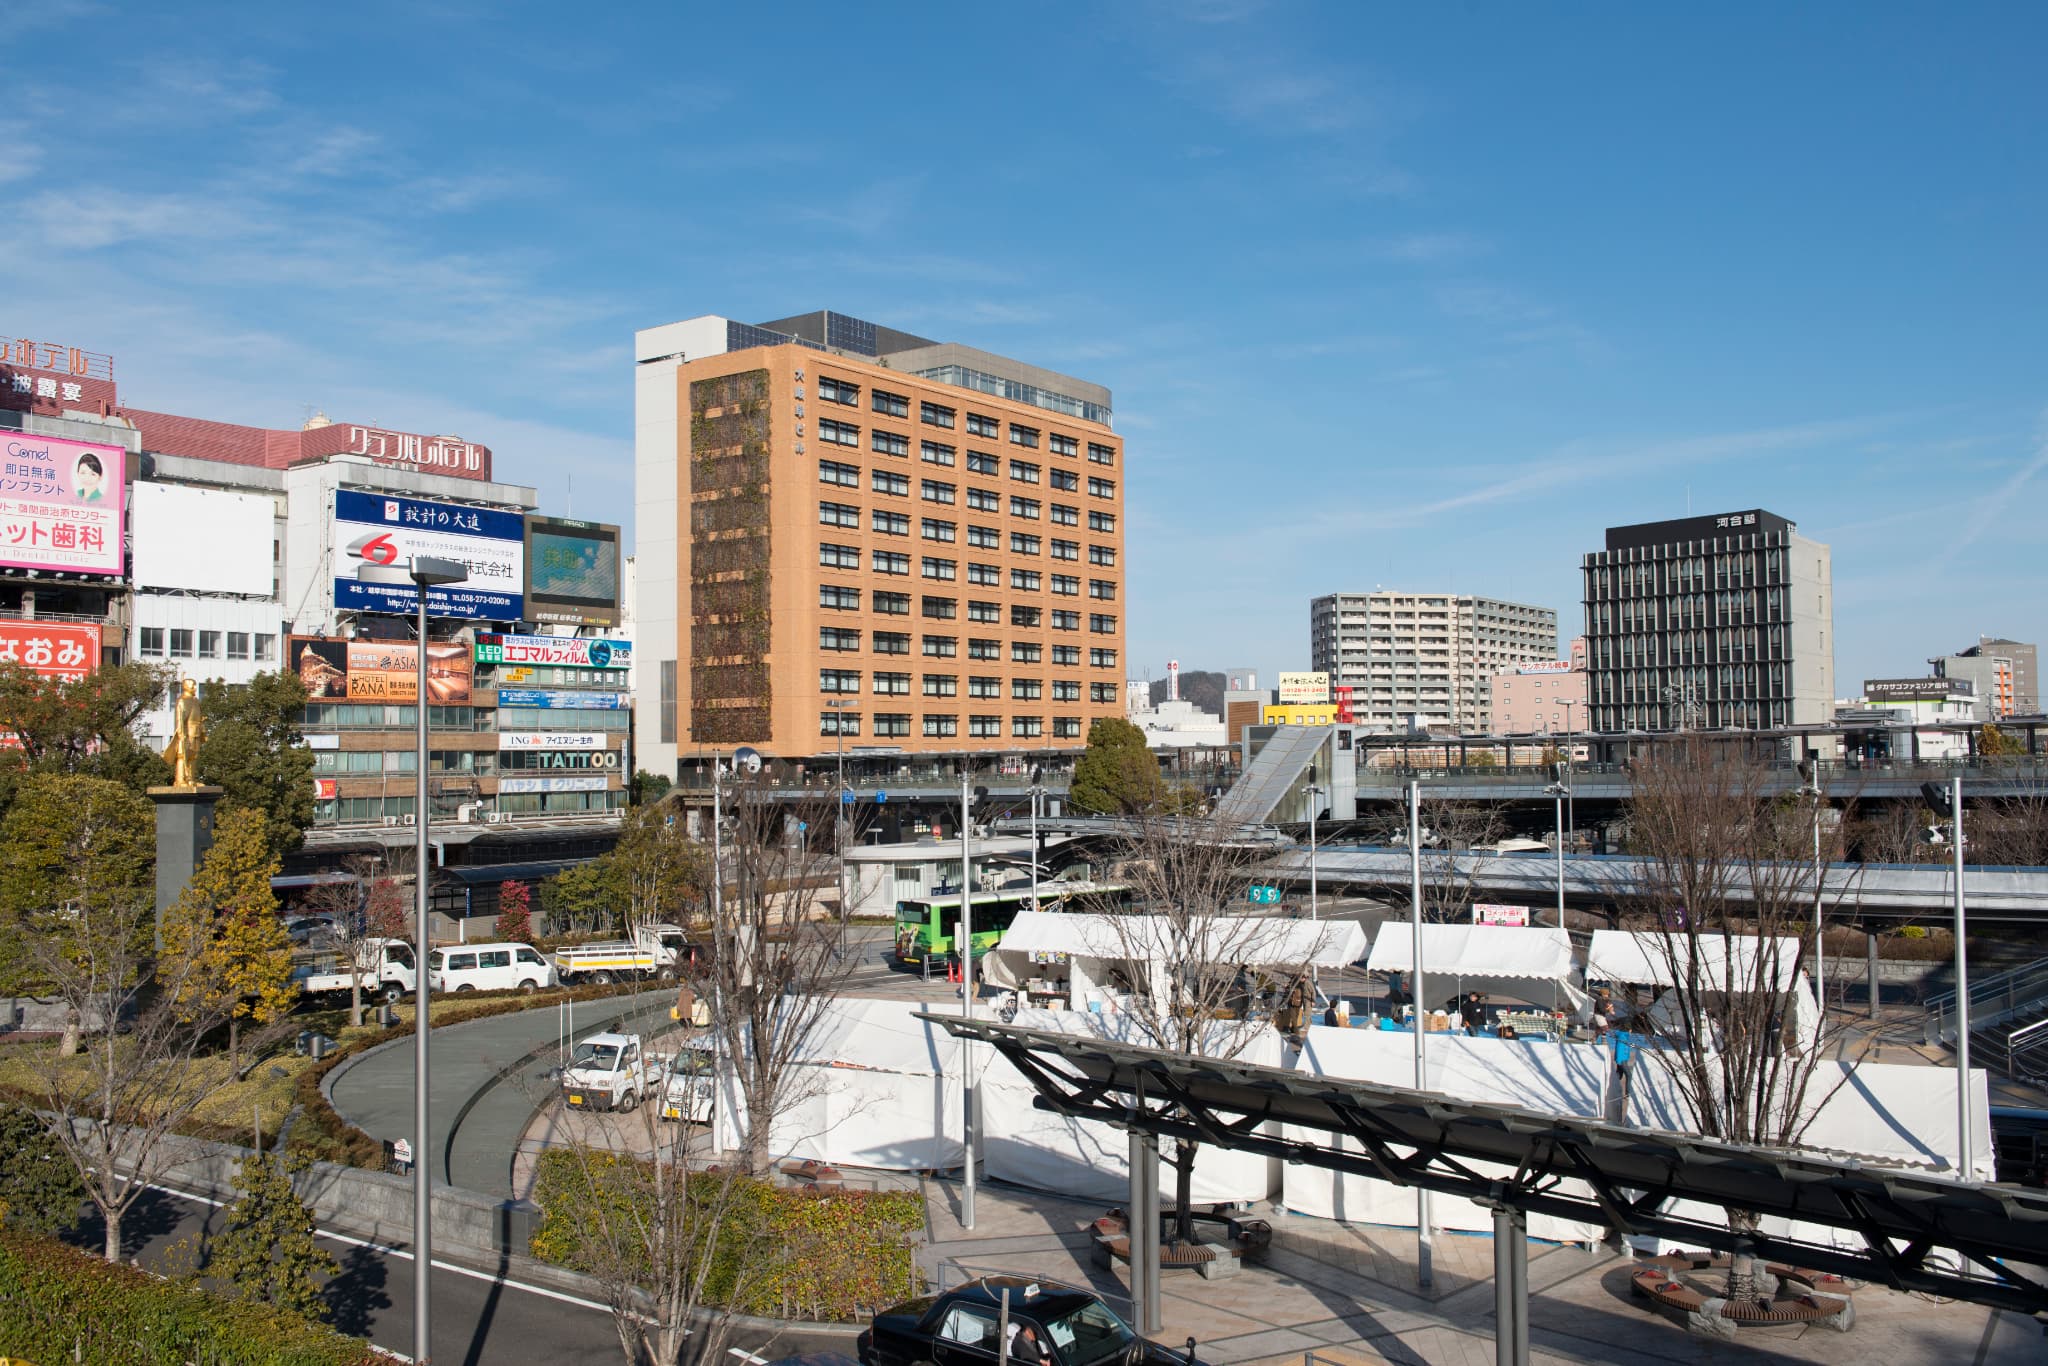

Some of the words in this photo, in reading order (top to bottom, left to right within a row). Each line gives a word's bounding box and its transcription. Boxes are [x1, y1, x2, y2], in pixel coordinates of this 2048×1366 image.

[7, 442, 54, 462] Comet
[350, 426, 480, 471] グランパレホテル
[5, 463, 56, 481] 即日無痛
[404, 507, 482, 531] 設計の大進
[1716, 513, 1756, 529] 河合塾
[0, 520, 105, 552] ット歯科
[478, 645, 502, 655] LED
[505, 645, 590, 665] エコマルフィルム
[393, 656, 417, 670] ASIA
[1521, 661, 1569, 671] サンホテル岐阜
[358, 675, 385, 683] HOTEL
[351, 682, 386, 696] RANA
[511, 736, 530, 745] ING
[540, 752, 617, 768] TATTOO
[1253, 888, 1261, 901] 9
